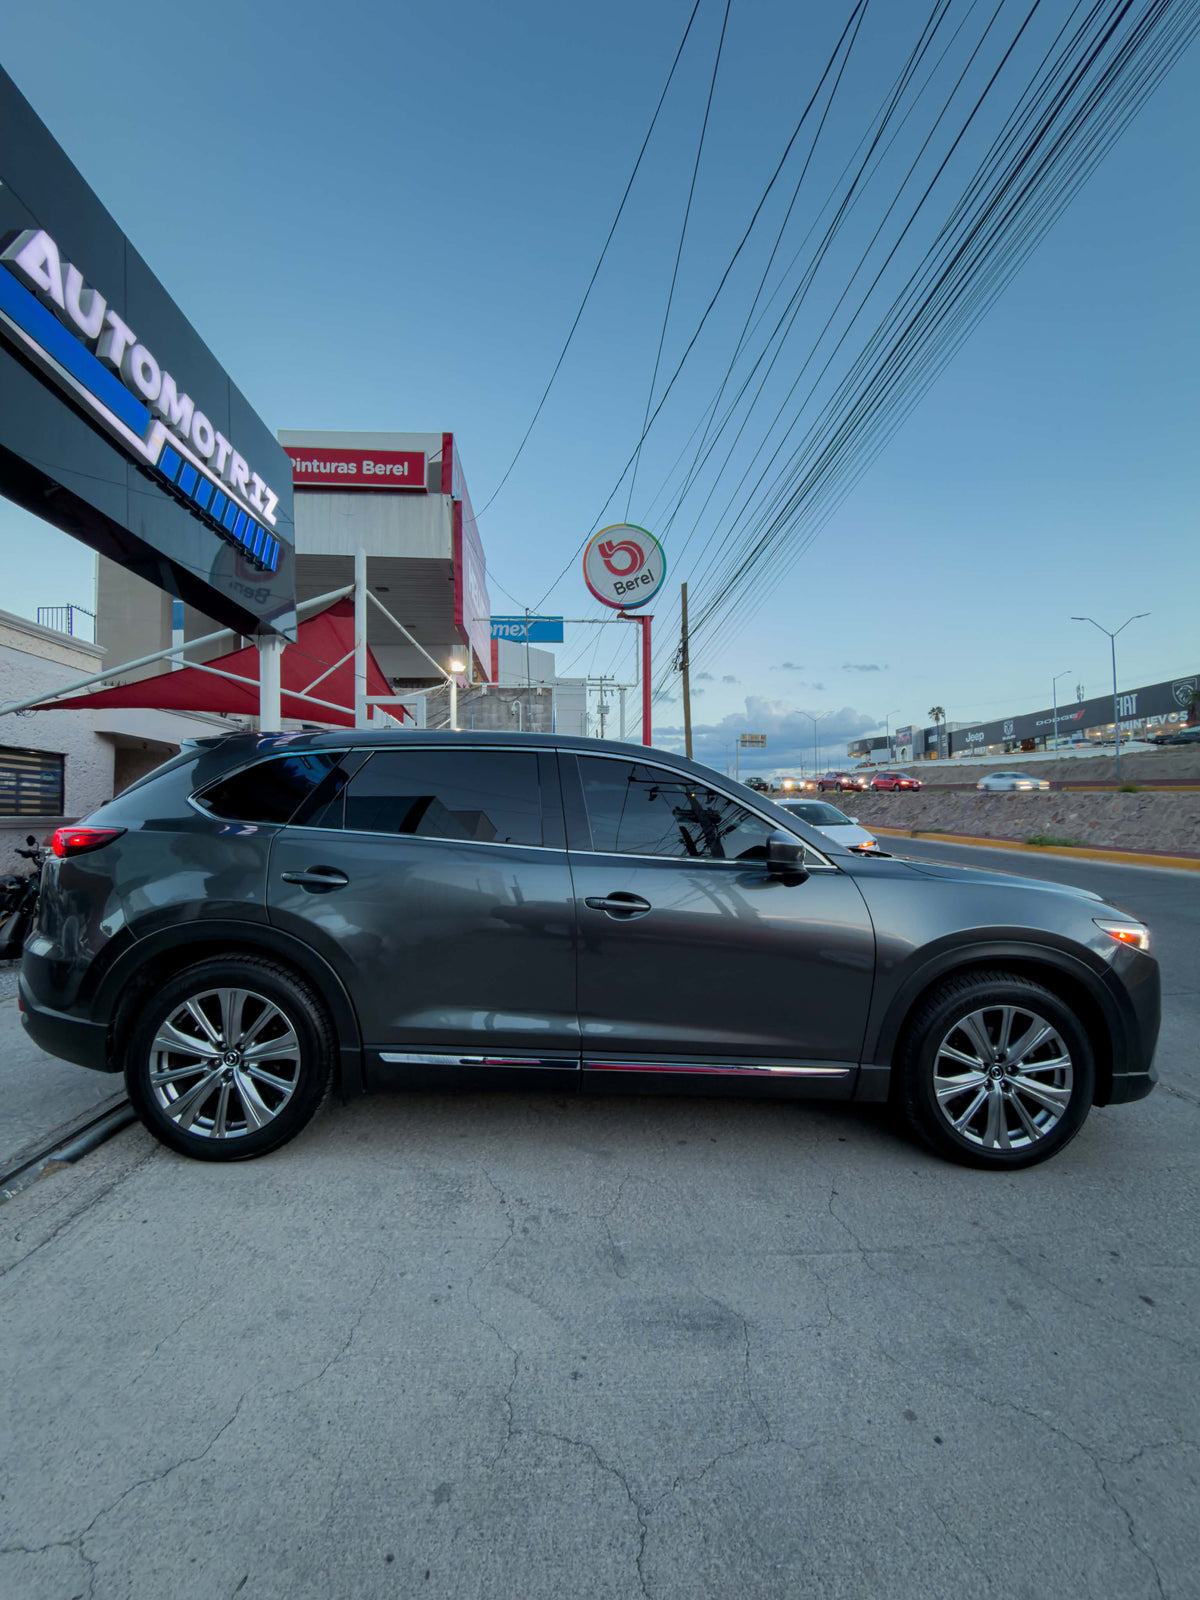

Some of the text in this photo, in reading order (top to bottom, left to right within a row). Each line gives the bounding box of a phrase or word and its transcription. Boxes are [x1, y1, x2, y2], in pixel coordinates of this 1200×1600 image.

[12, 229, 279, 526] AUTOMOTRIZ
[362, 460, 409, 476] Berel
[613, 568, 655, 596] Berel
[490, 619, 537, 637] mex
[1036, 713, 1078, 726] DODGE
[965, 731, 985, 743] Jeep
